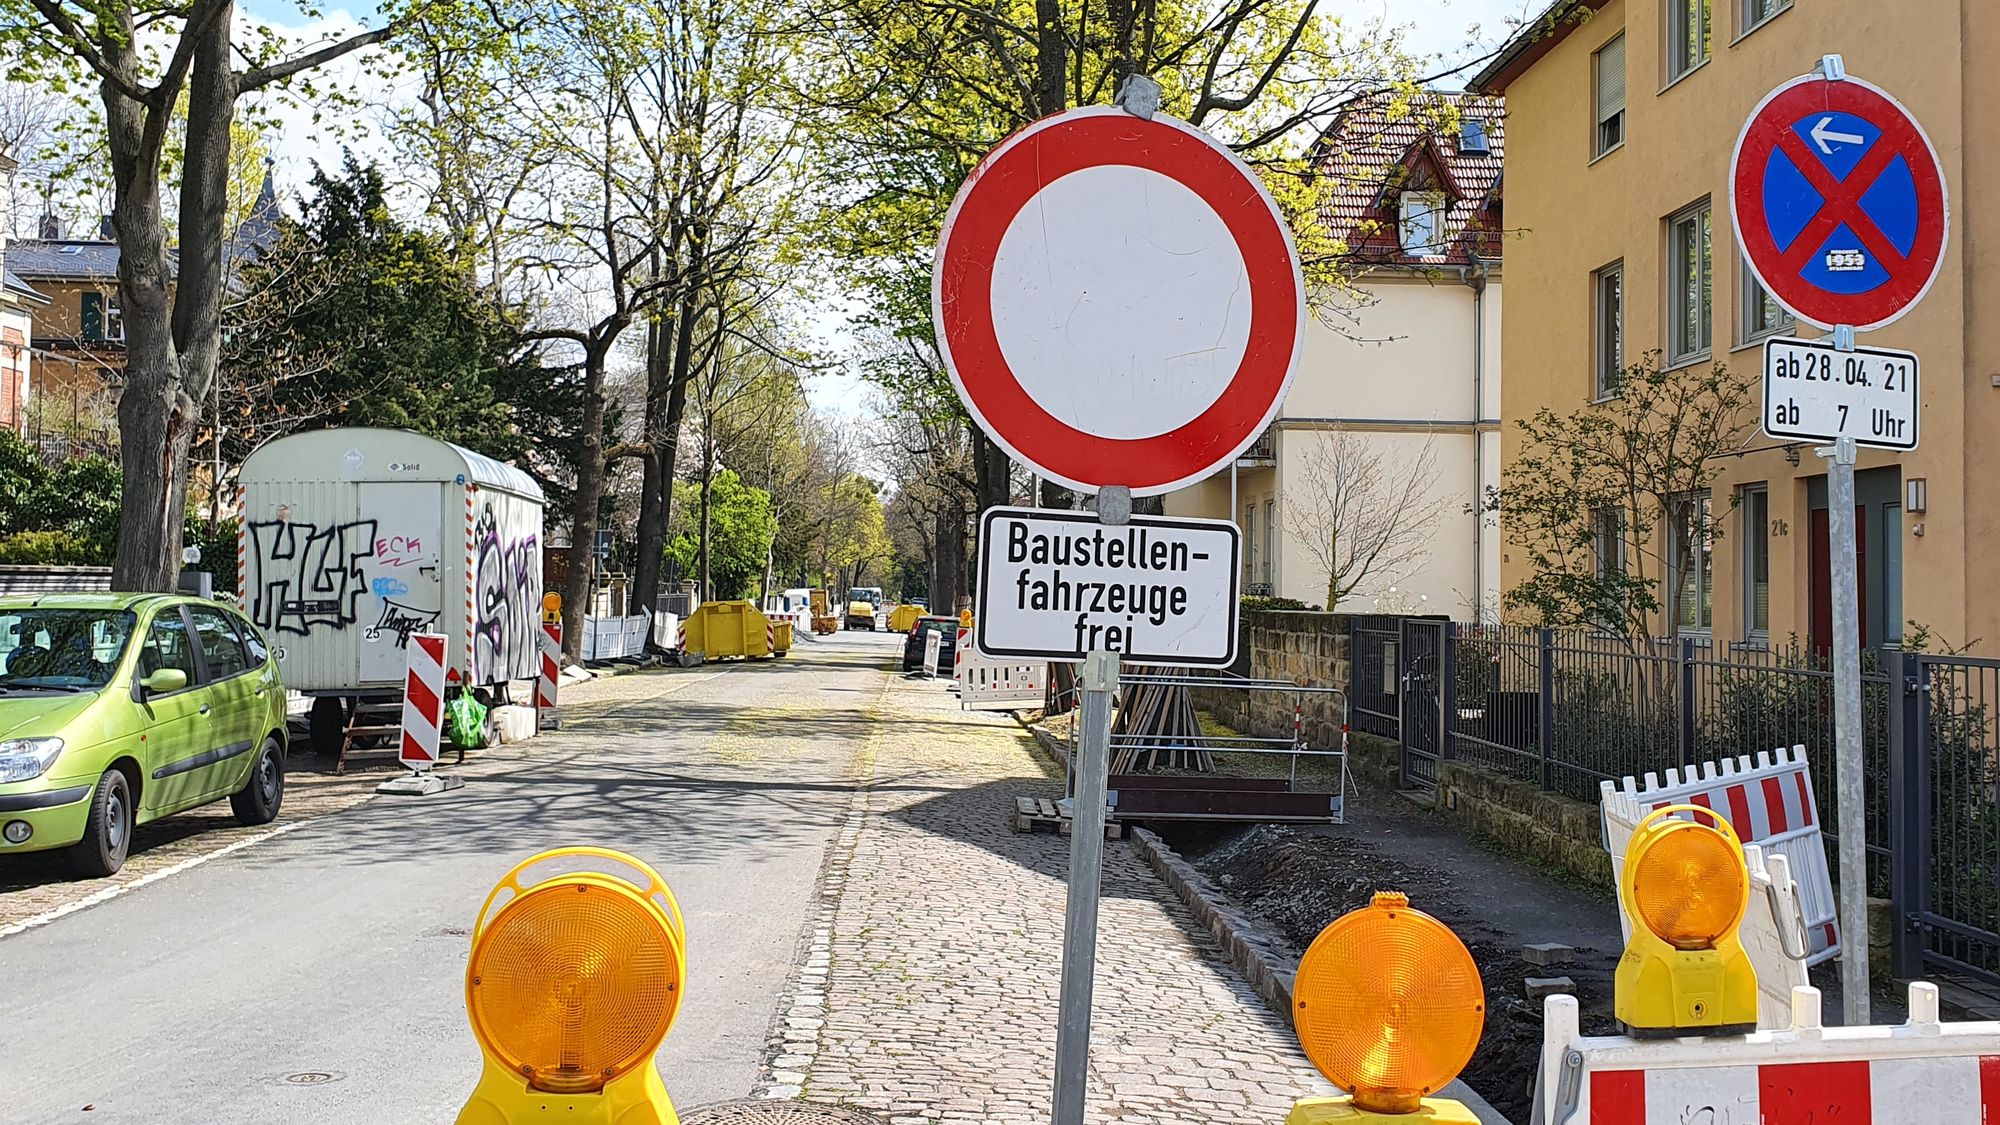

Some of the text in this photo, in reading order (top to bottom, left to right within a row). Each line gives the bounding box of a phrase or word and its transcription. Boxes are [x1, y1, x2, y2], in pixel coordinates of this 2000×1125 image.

[1776, 351, 1800, 379] ab
[1776, 397, 1906, 439] ab 7 Uhr
[1771, 518, 1788, 536] 21c
[375, 536, 421, 558] ECK
[1008, 521, 1209, 572] Baustellen-
[1016, 568, 1187, 626] fahrzeuge
[365, 627, 381, 640] 25
[1074, 612, 1134, 655] frei
